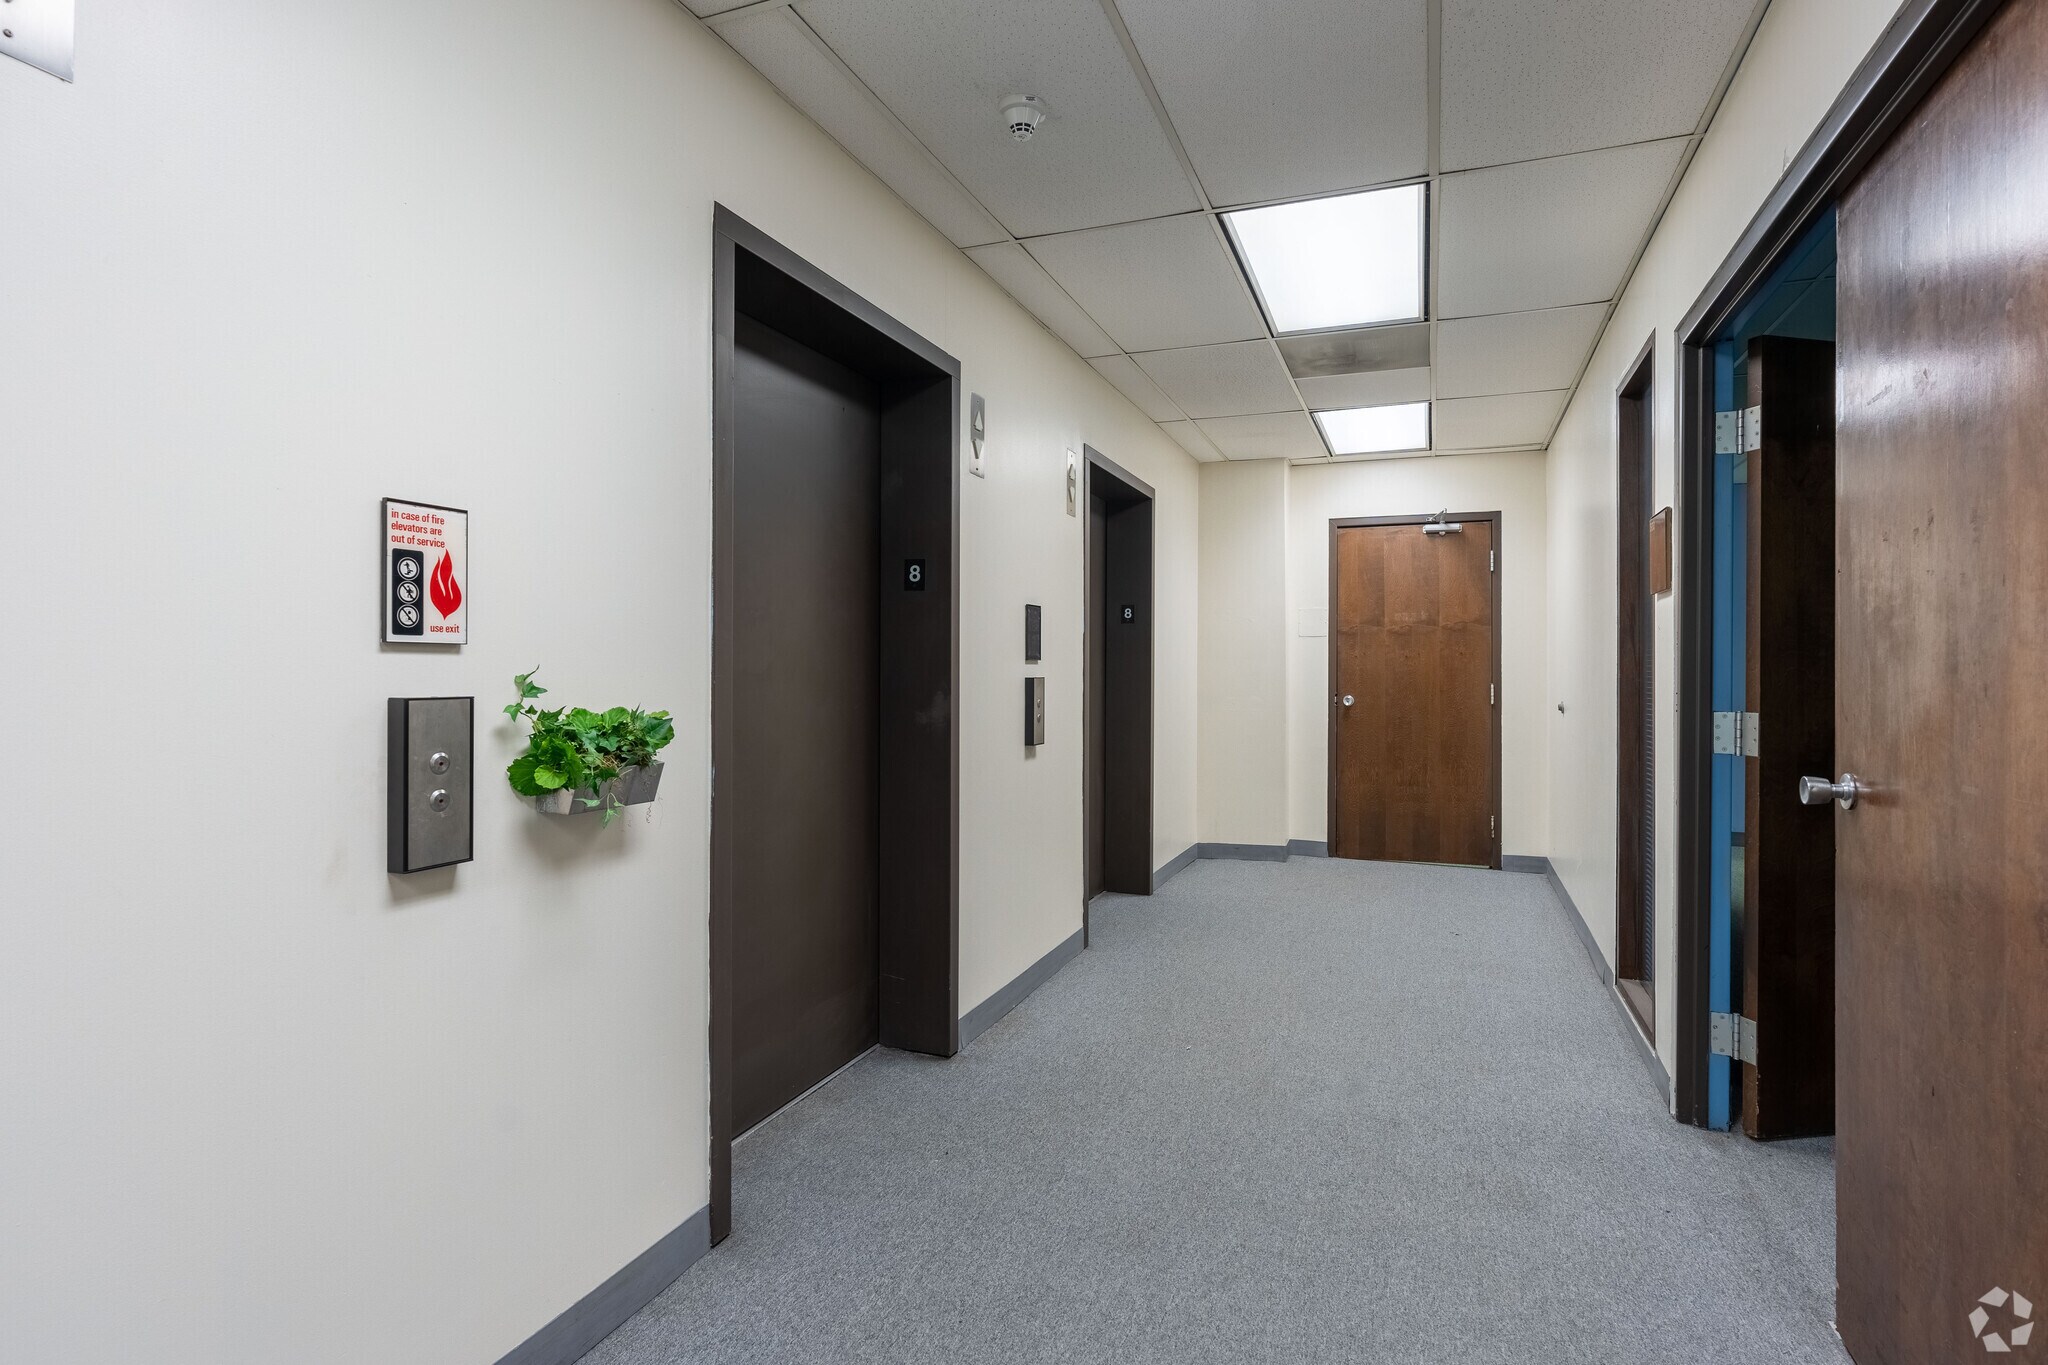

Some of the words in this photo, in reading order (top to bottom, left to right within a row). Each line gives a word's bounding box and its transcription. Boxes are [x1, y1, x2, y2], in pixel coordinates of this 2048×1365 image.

[391, 508, 399, 518] in
[401, 512, 420, 521] case
[422, 513, 430, 522] of
[431, 514, 445, 525] fire
[391, 521, 428, 534] elevators
[429, 527, 442, 536] are
[391, 534, 405, 543] out
[407, 535, 415, 544] of
[416, 537, 445, 548] service
[909, 565, 921, 582] 8
[1124, 607, 1132, 619] 8
[430, 625, 444, 633] use
[445, 623, 460, 633] exit
